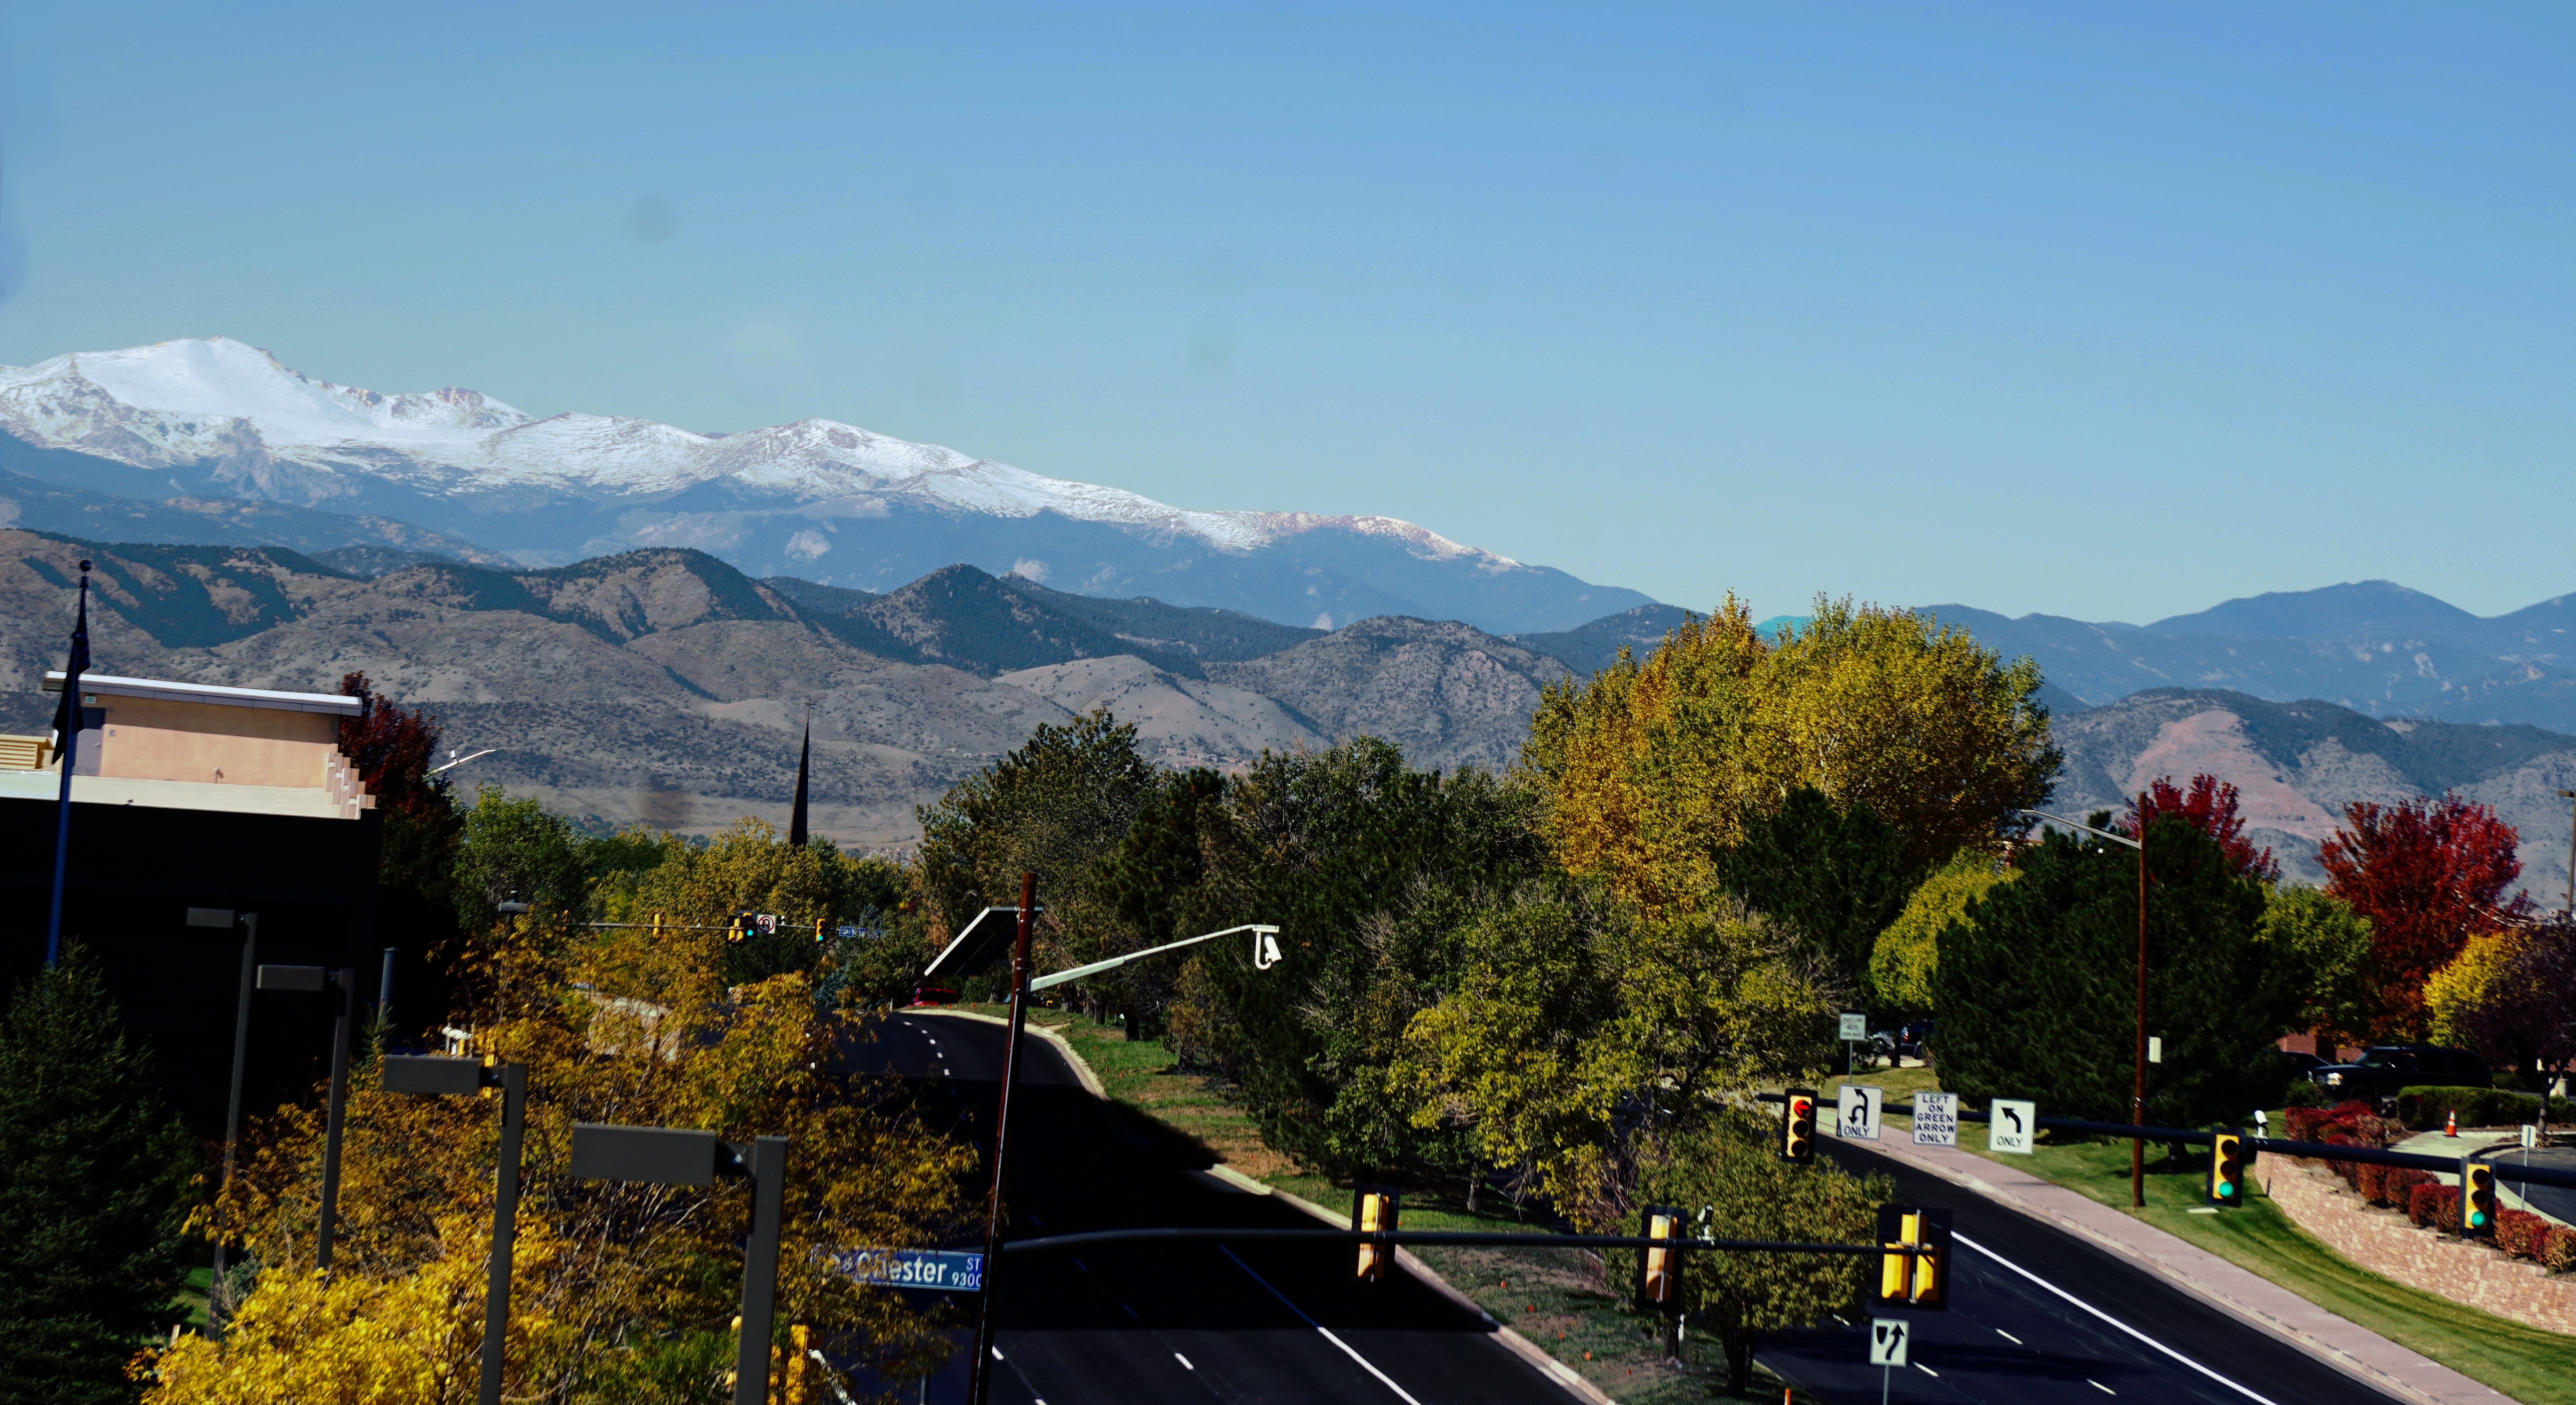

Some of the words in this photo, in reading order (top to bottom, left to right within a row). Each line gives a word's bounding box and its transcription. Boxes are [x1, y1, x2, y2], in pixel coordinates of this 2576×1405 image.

[1922, 1093, 1950, 1105] LEFT
[1928, 1104, 1944, 1114] ON
[1917, 1112, 1954, 1123] GREEN
[1844, 1125, 1870, 1138] ONLY
[1915, 1122, 1956, 1133] ARROW
[1919, 1133, 1949, 1143] ONLY
[1997, 1135, 2024, 1148] ONLY
[966, 1257, 981, 1272] ST
[952, 1271, 982, 1288] 9300
